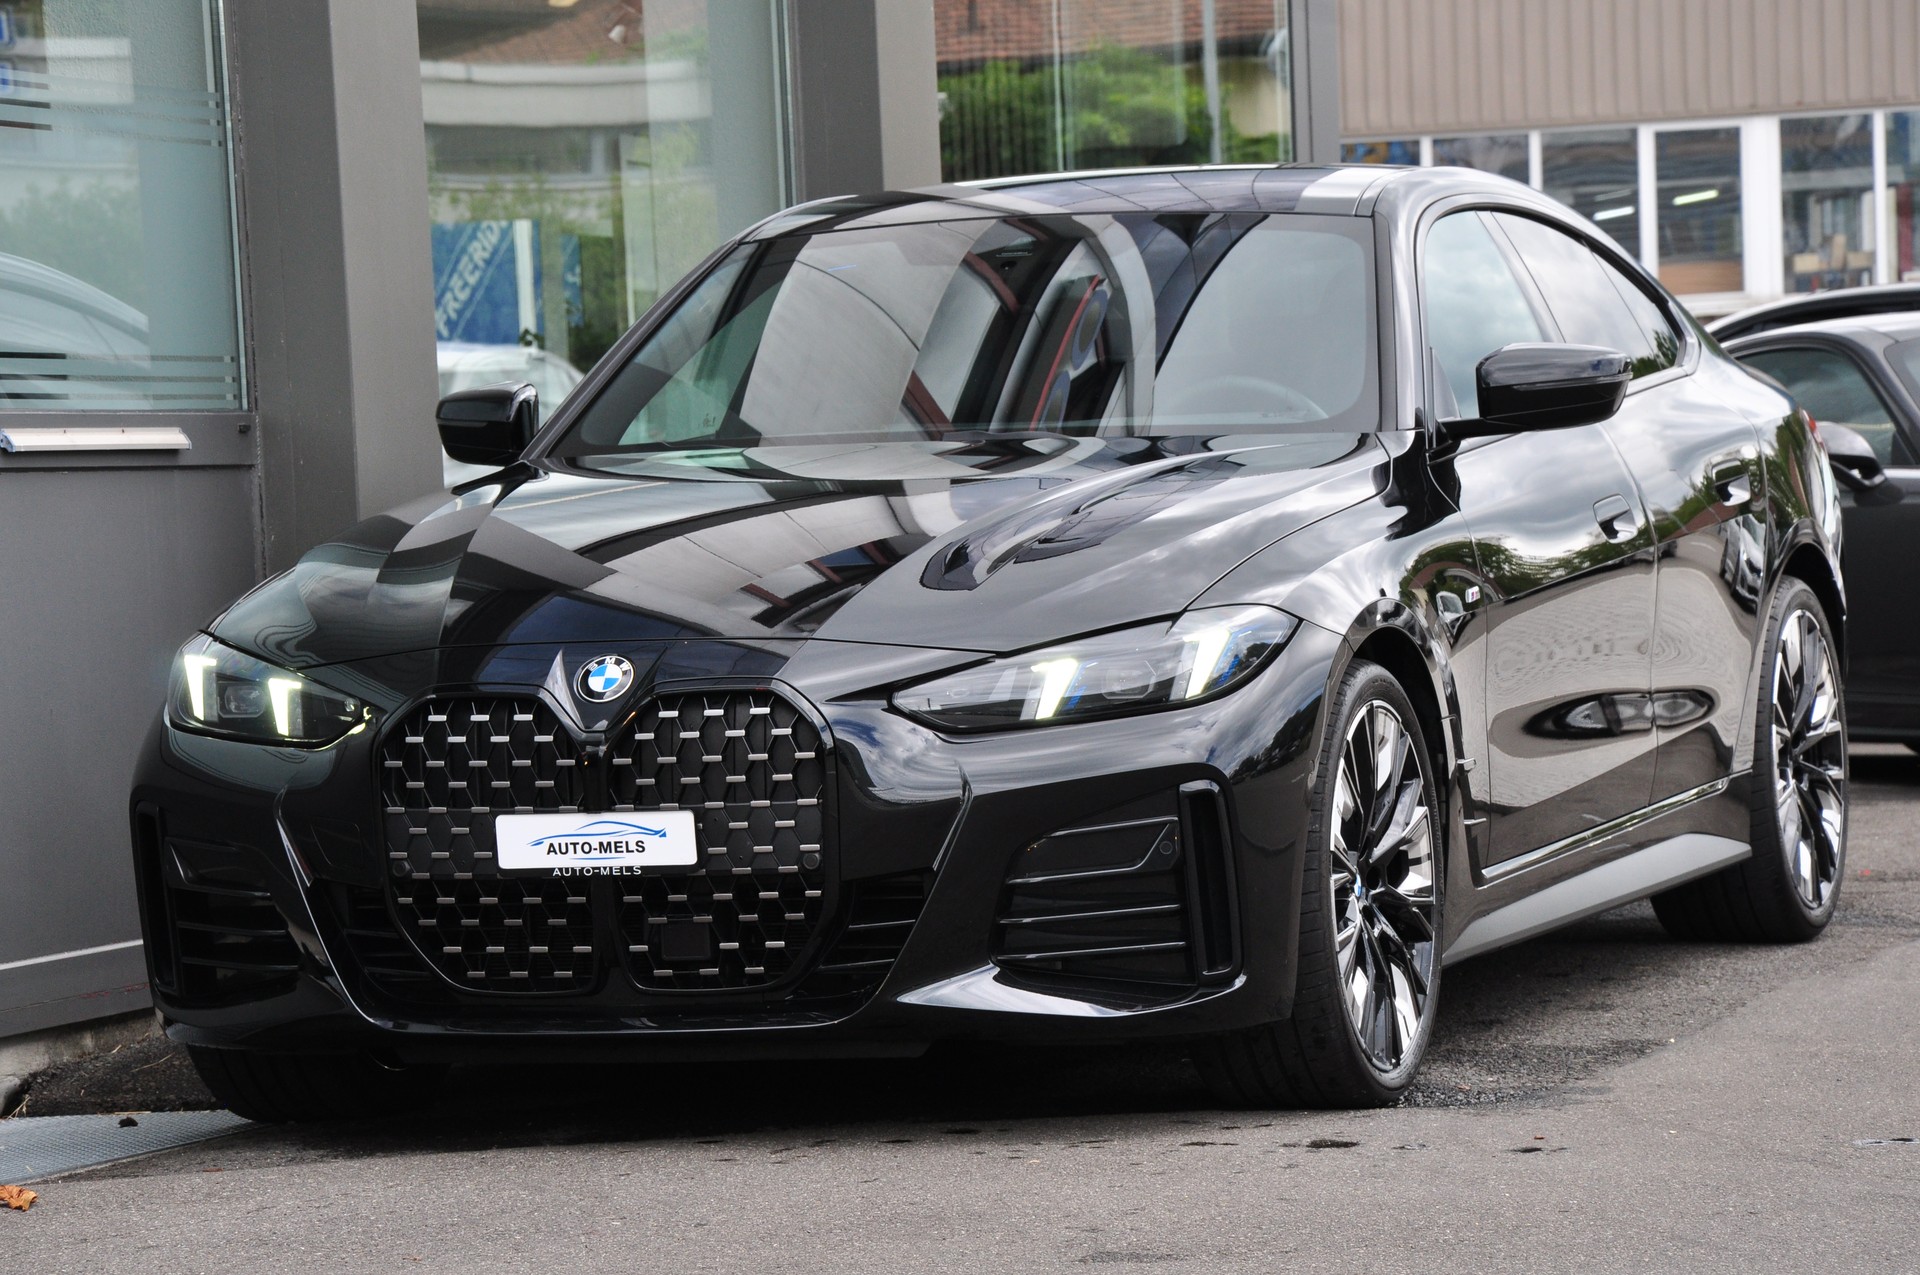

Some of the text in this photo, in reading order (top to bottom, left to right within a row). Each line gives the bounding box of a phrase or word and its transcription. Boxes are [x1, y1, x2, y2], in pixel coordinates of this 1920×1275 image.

[588, 657, 631, 672] BMW
[546, 840, 646, 855] AUTO-MELS
[552, 865, 642, 876] AUTO-MELS
